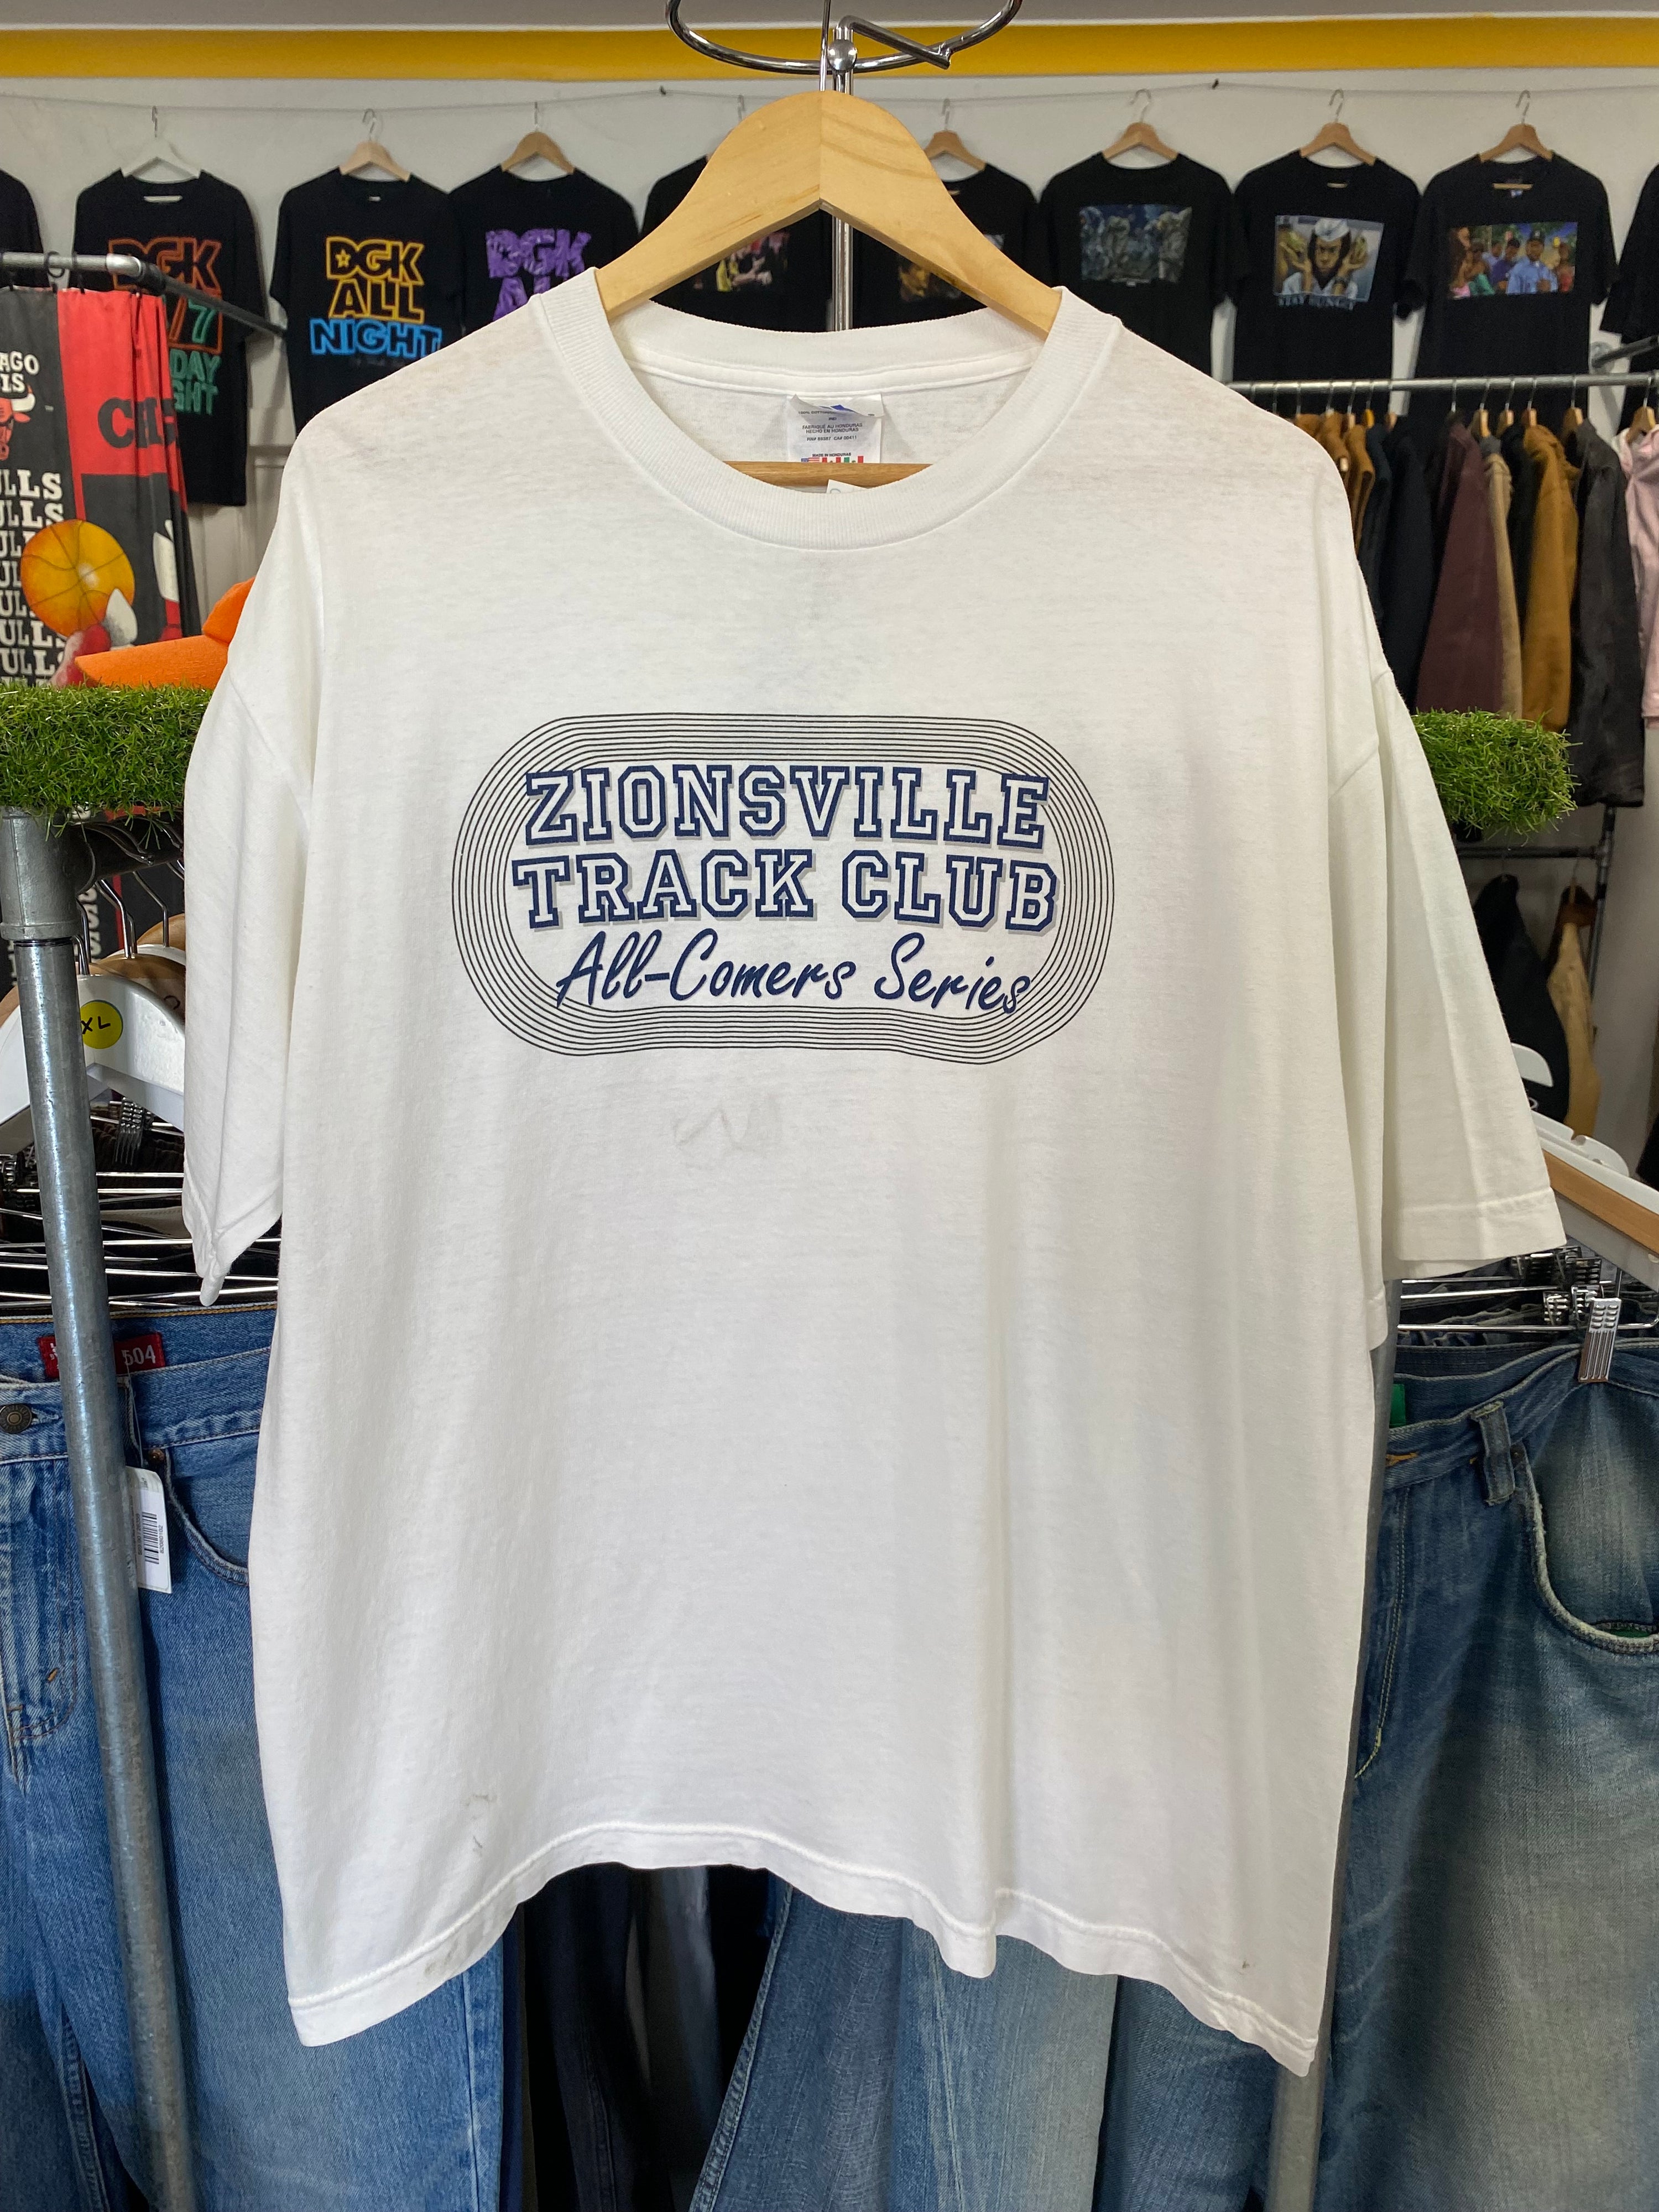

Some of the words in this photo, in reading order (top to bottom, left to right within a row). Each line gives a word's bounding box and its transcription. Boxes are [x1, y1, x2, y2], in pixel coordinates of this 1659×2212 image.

[326, 236, 424, 286] DGK
[486, 228, 591, 279] DGK
[330, 280, 424, 324] ALL
[310, 318, 442, 359] NIGHT
[170, 348, 221, 387] DAY
[0, 469, 62, 500] LLS
[526, 764, 1051, 849] ZIONSVILLE
[513, 849, 816, 929] TRACK
[841, 849, 1062, 936] CLUB
[555, 928, 855, 1009] All-Comers
[874, 929, 1031, 1015] Series
[81, 1016, 111, 1034] XL
[121, 1345, 155, 1365] 504
